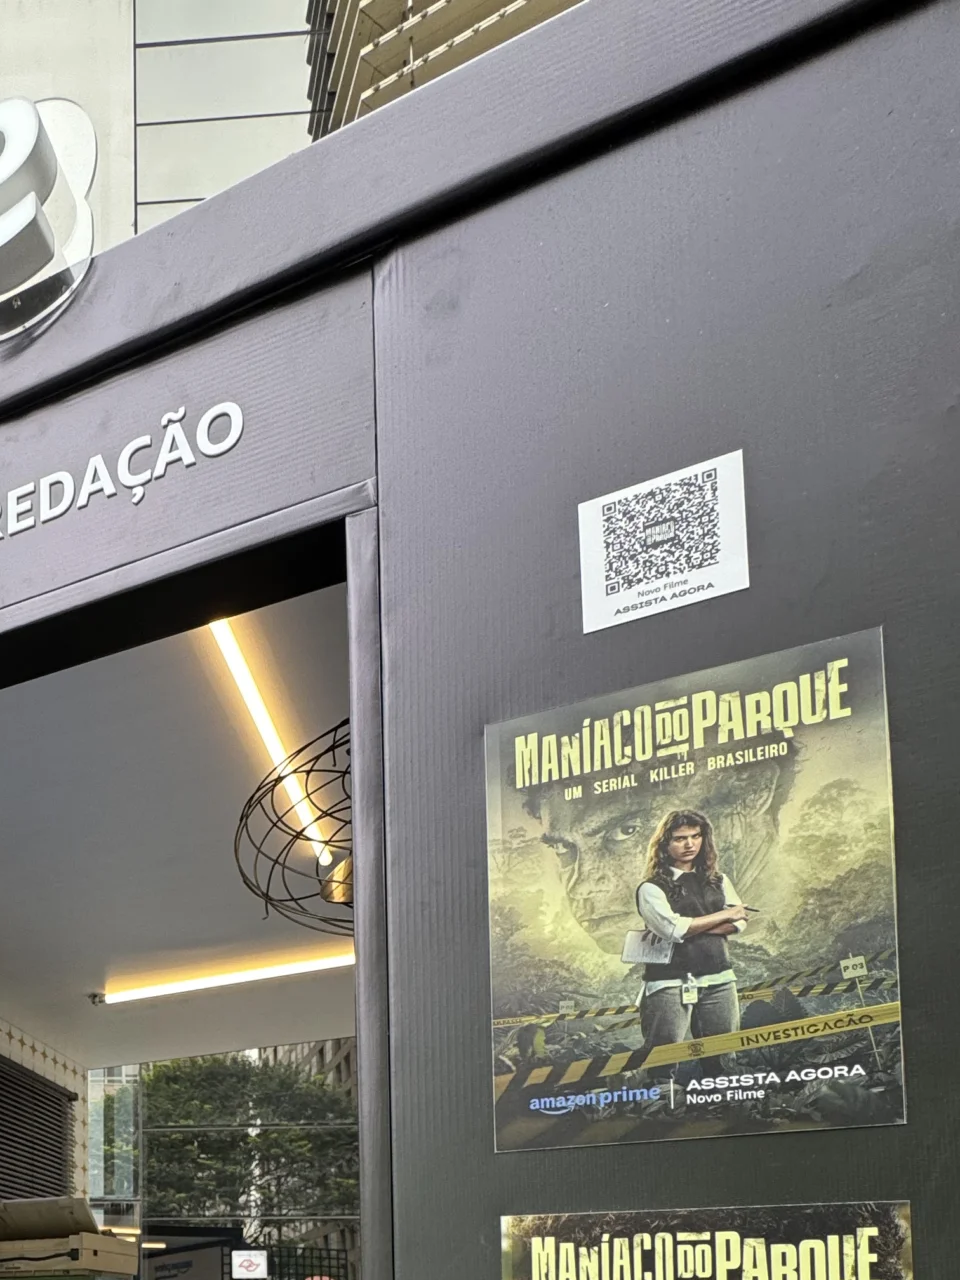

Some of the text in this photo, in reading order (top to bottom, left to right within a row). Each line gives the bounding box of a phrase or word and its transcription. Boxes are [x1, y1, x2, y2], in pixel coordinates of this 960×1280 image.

[614, 582, 715, 616] ASSISTA AGORA
[638, 578, 689, 598] Novo Filme
[515, 658, 852, 789] MANÍACO DO PARQUE
[564, 741, 788, 801] UM SERIAL KILLER BRASILEIRO
[686, 1064, 866, 1091] ASSISTA AGORA
[529, 1086, 661, 1111] amazon prime
[686, 1087, 765, 1105] Novo Filme
